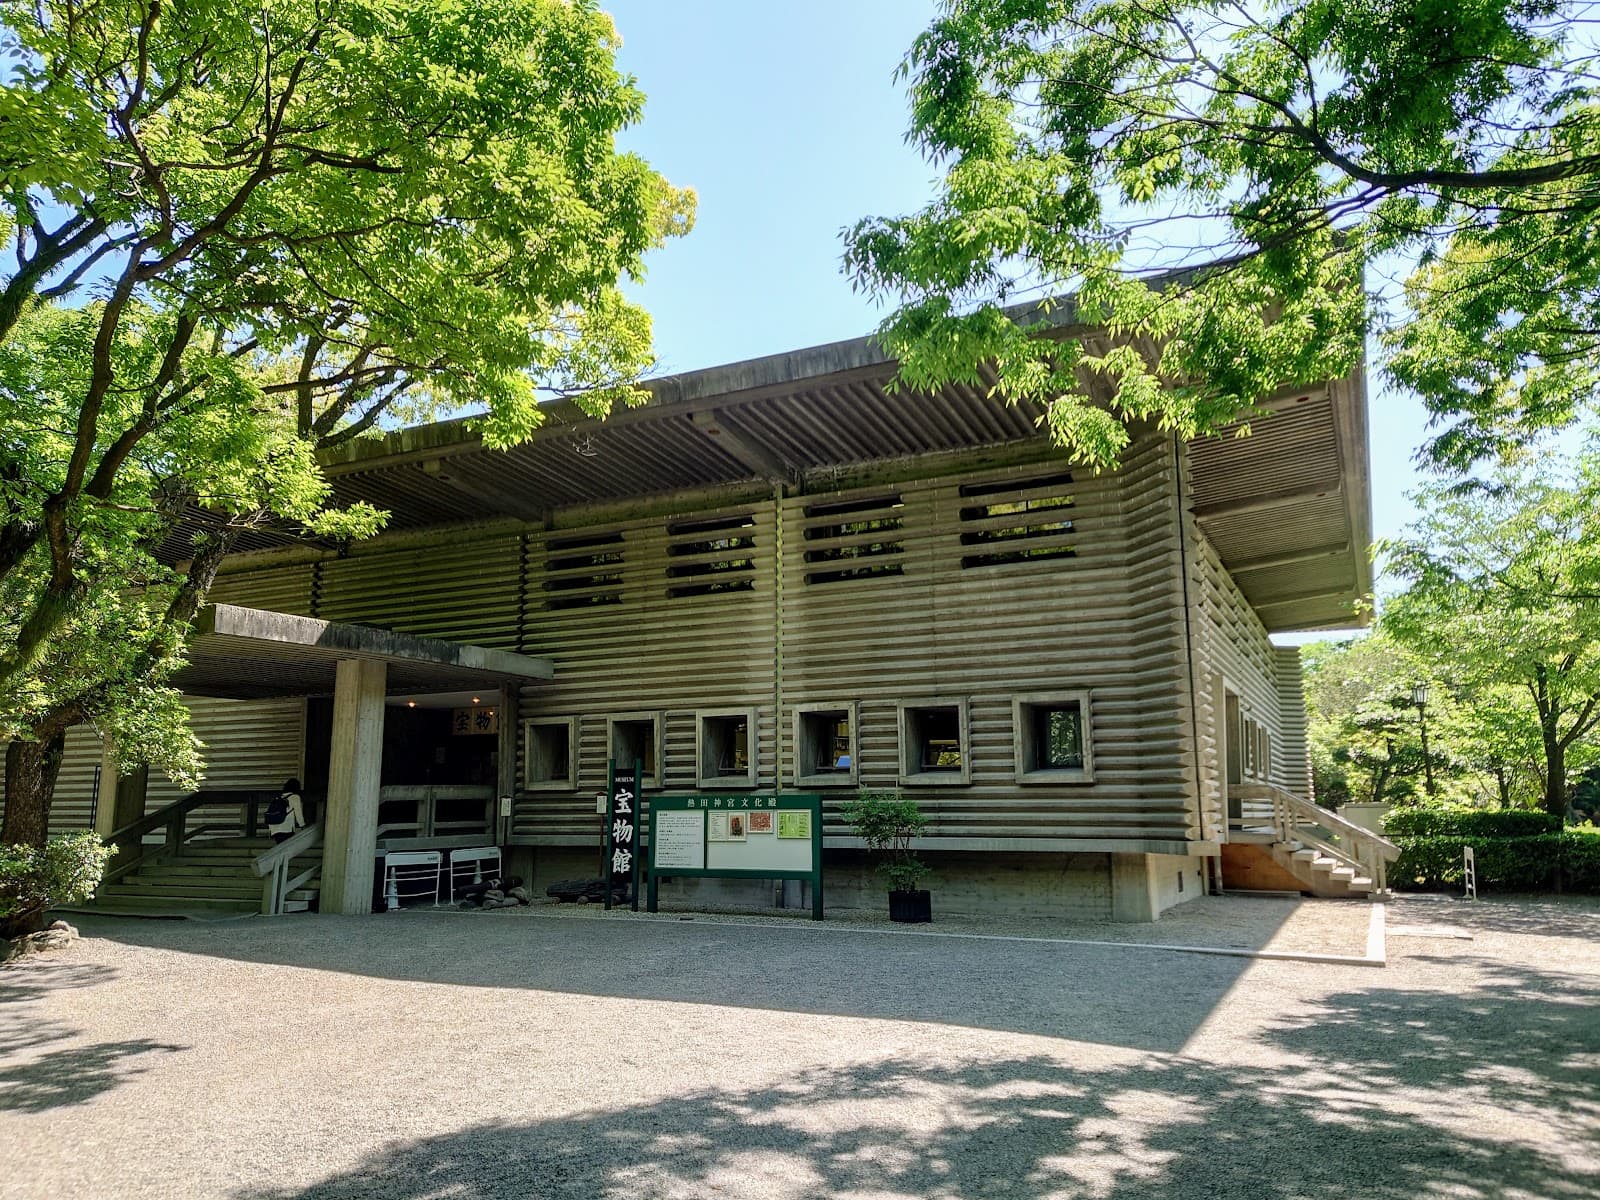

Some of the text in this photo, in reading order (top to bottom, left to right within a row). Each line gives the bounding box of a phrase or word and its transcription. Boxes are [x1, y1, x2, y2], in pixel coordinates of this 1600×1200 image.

[456, 711, 499, 731] 宝物
[687, 797, 777, 808] 熱田神宮文化殿
[611, 788, 634, 874] 宝物館
